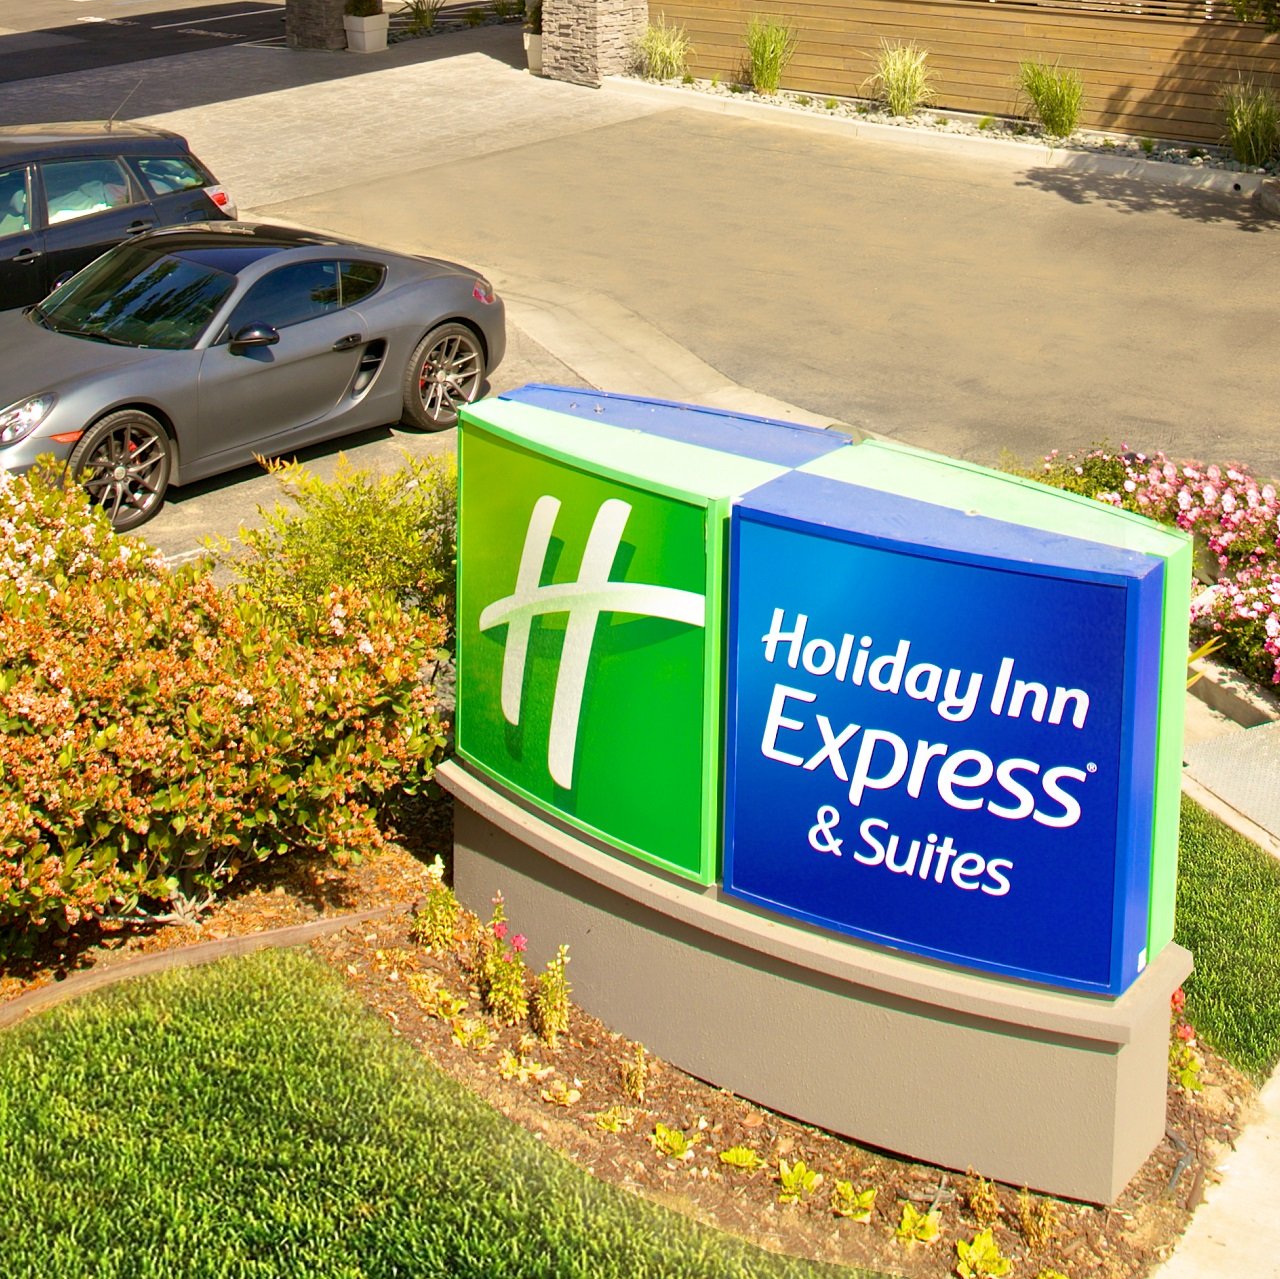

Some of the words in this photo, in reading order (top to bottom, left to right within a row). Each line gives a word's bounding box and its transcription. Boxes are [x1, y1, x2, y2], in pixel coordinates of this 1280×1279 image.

[762, 608, 982, 722] Holiday
[990, 657, 1090, 729] Inn
[761, 683, 1088, 828] Express
[808, 805, 842, 856] &
[854, 817, 1014, 897] Suites
